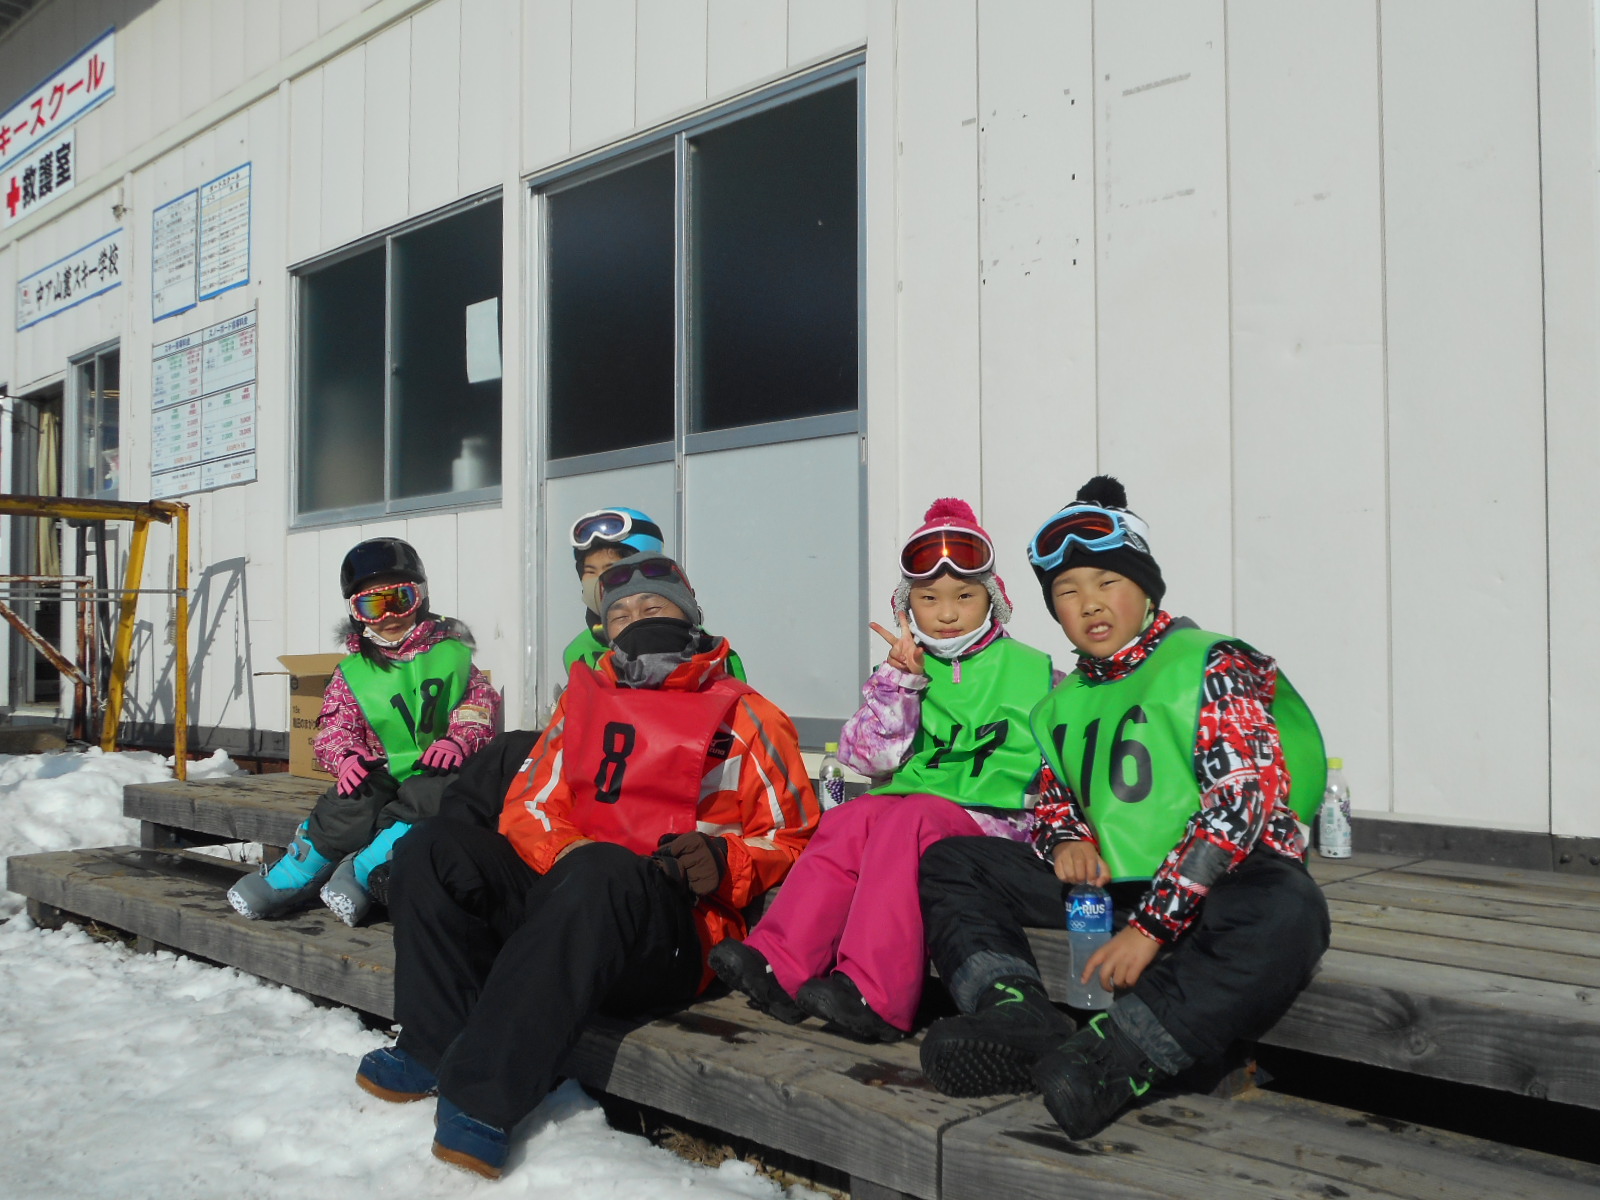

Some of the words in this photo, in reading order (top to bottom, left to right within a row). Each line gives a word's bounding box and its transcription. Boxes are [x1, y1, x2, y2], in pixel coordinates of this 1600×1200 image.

[0, 53, 106, 156] キースクール
[390, 678, 444, 748] 18
[926, 718, 1009, 777] 17
[594, 721, 636, 804] 8
